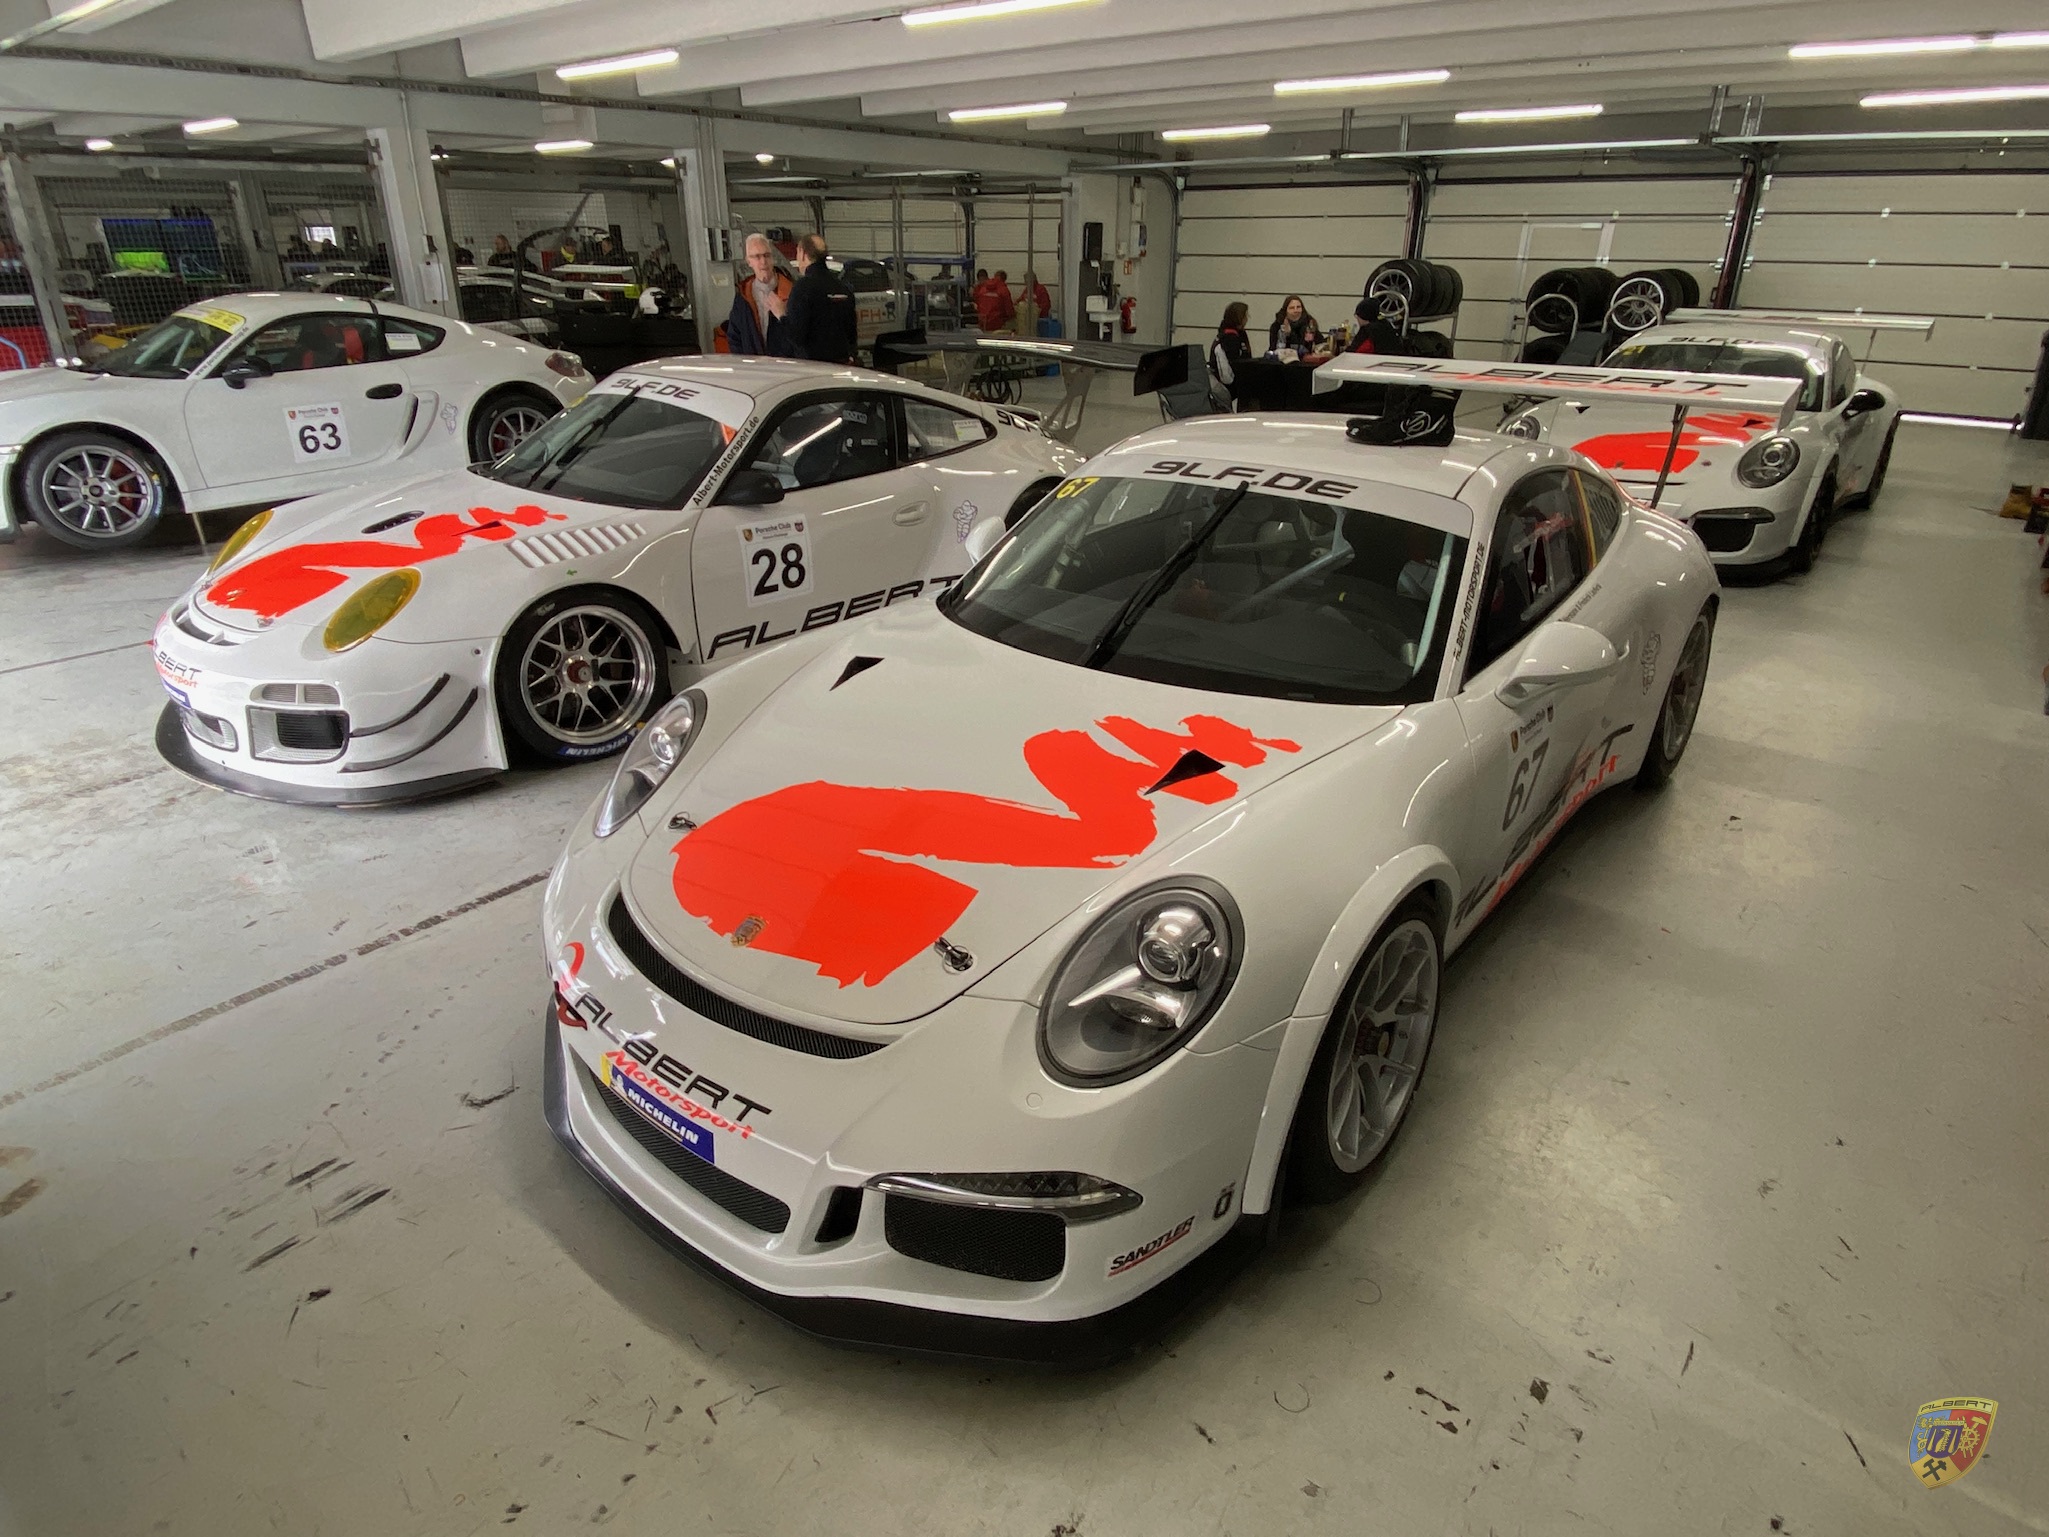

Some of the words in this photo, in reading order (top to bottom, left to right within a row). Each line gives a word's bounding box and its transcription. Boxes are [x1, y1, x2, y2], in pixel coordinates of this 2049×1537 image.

[611, 379, 701, 400] 9LF.DE
[1366, 361, 1748, 391] ALBERT
[299, 423, 341, 453] 63
[692, 416, 759, 506] Albert-Motorsport.de
[1056, 477, 1100, 499] 67
[1143, 460, 1359, 499] 9LF.DE
[755, 525, 778, 534] Porsche
[752, 543, 806, 597] 28
[1502, 737, 1550, 831] 67
[575, 991, 773, 1122] ALBERT
[605, 1050, 756, 1139] Motorsport
[628, 1087, 699, 1145] MICHELIN
[1110, 1215, 1196, 1270] SANDTLER
